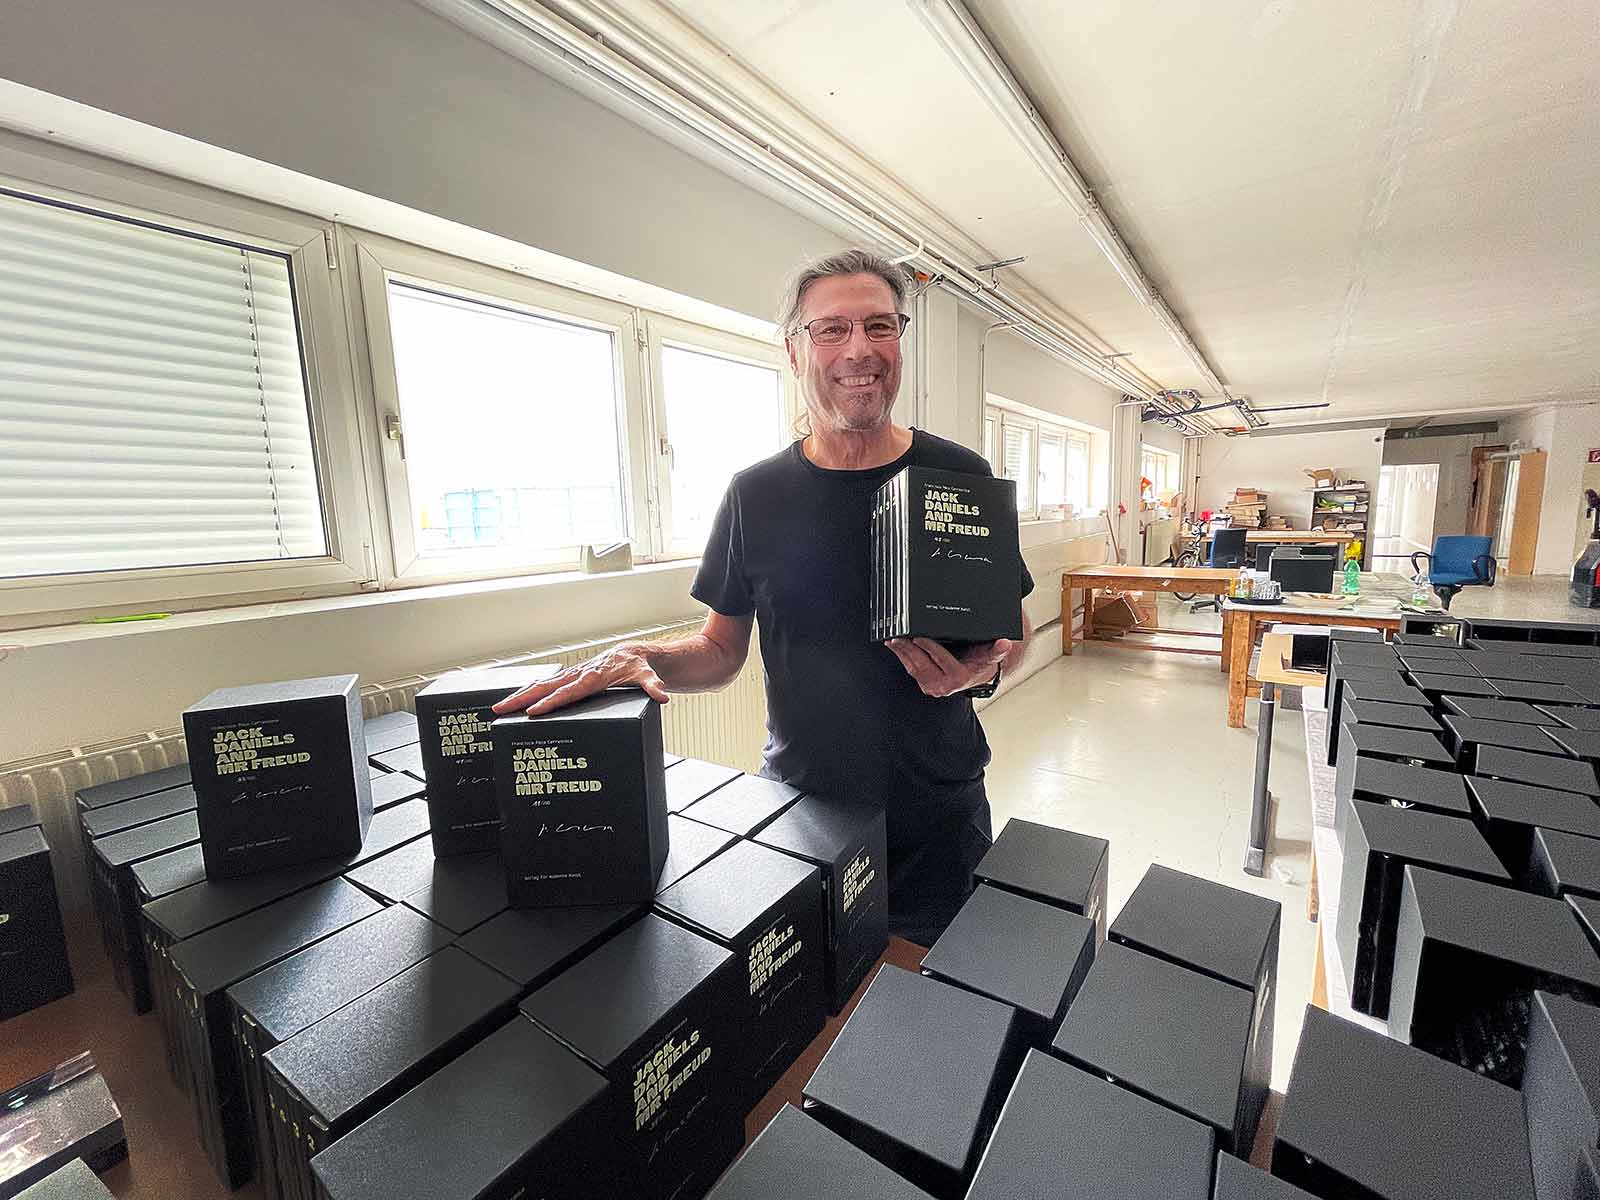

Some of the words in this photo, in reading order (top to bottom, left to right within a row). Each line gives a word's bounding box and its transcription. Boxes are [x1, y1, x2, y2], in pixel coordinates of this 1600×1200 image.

[925, 490, 959, 503] JACK
[925, 500, 980, 516] DANIELS
[925, 511, 953, 523] AND
[925, 520, 946, 533] MR
[948, 523, 990, 537] FREUD
[438, 712, 479, 726] JACK
[213, 727, 263, 743] JACK
[214, 733, 295, 754] DANIELS
[441, 733, 475, 746] AND
[216, 749, 258, 765] AND
[441, 744, 467, 757] MR
[512, 746, 558, 760] JACK
[217, 761, 249, 775] MR
[251, 752, 311, 770] FREUD
[514, 757, 588, 772] DANIELS
[515, 771, 552, 783] AND
[516, 783, 544, 796] MR
[547, 781, 602, 794] FREUD
[843, 857, 859, 883] JACK
[843, 856, 870, 893] DANIELS
[844, 893, 854, 913] MR
[854, 869, 875, 899] FREUD
[844, 880, 857, 903] AND
[749, 927, 777, 960] JACK
[749, 925, 794, 973] DANIELS
[749, 955, 773, 984] AND
[750, 971, 767, 996] MR
[768, 940, 802, 977] FREUD
[633, 1037, 676, 1087] JACK
[633, 1030, 700, 1103] DANIELS
[635, 1095, 661, 1131] MR
[664, 1047, 712, 1101] FREUD
[635, 1073, 669, 1117] AND
